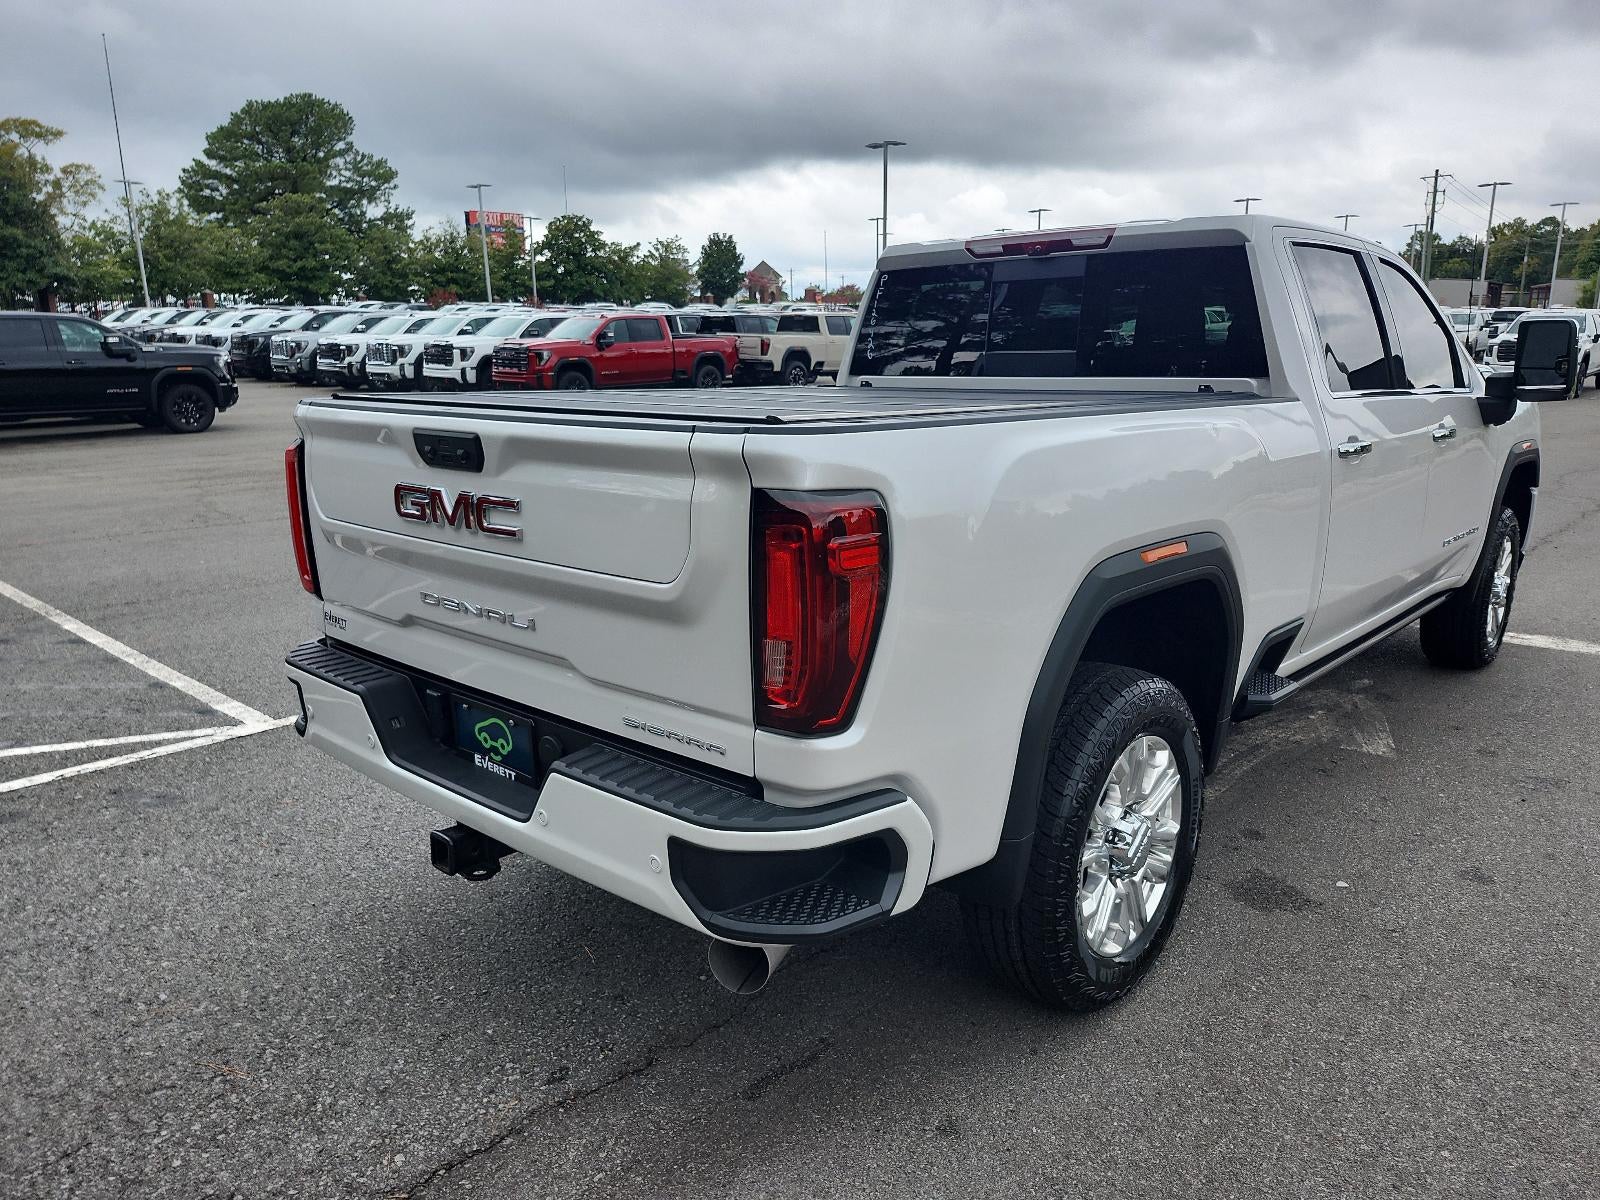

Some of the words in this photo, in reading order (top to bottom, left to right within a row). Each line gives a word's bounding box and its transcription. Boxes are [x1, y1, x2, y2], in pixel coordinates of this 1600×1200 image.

[484, 212, 501, 226] EXIT
[394, 482, 523, 541] GMC
[419, 590, 536, 632] DENALI
[622, 716, 727, 756] SIERRA
[474, 753, 516, 781] EVERETT
